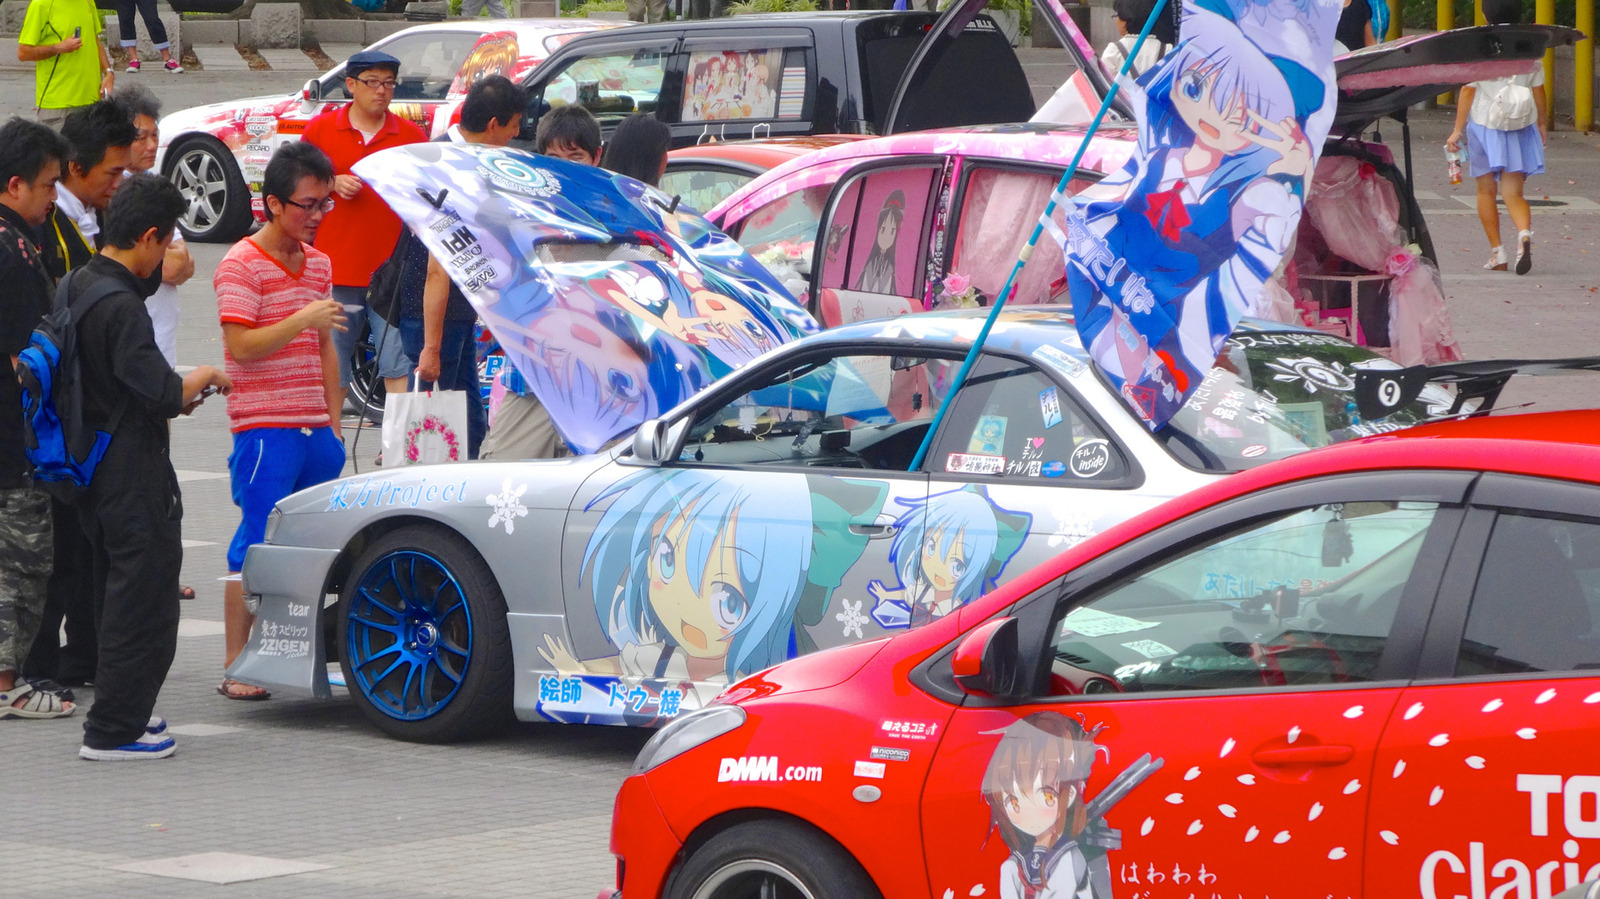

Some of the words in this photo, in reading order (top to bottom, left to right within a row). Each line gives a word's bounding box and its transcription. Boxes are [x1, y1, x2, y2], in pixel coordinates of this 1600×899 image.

[440, 225, 478, 256] HPI
[464, 265, 497, 293] RAYS
[1384, 382, 1396, 403] 9
[1078, 455, 1105, 471] inside
[288, 601, 310, 617] tear
[538, 676, 583, 705] 絵師
[717, 755, 823, 783] DMM.com
[1120, 861, 1218, 885] はわわわ
[1419, 839, 1600, 899] Clari
